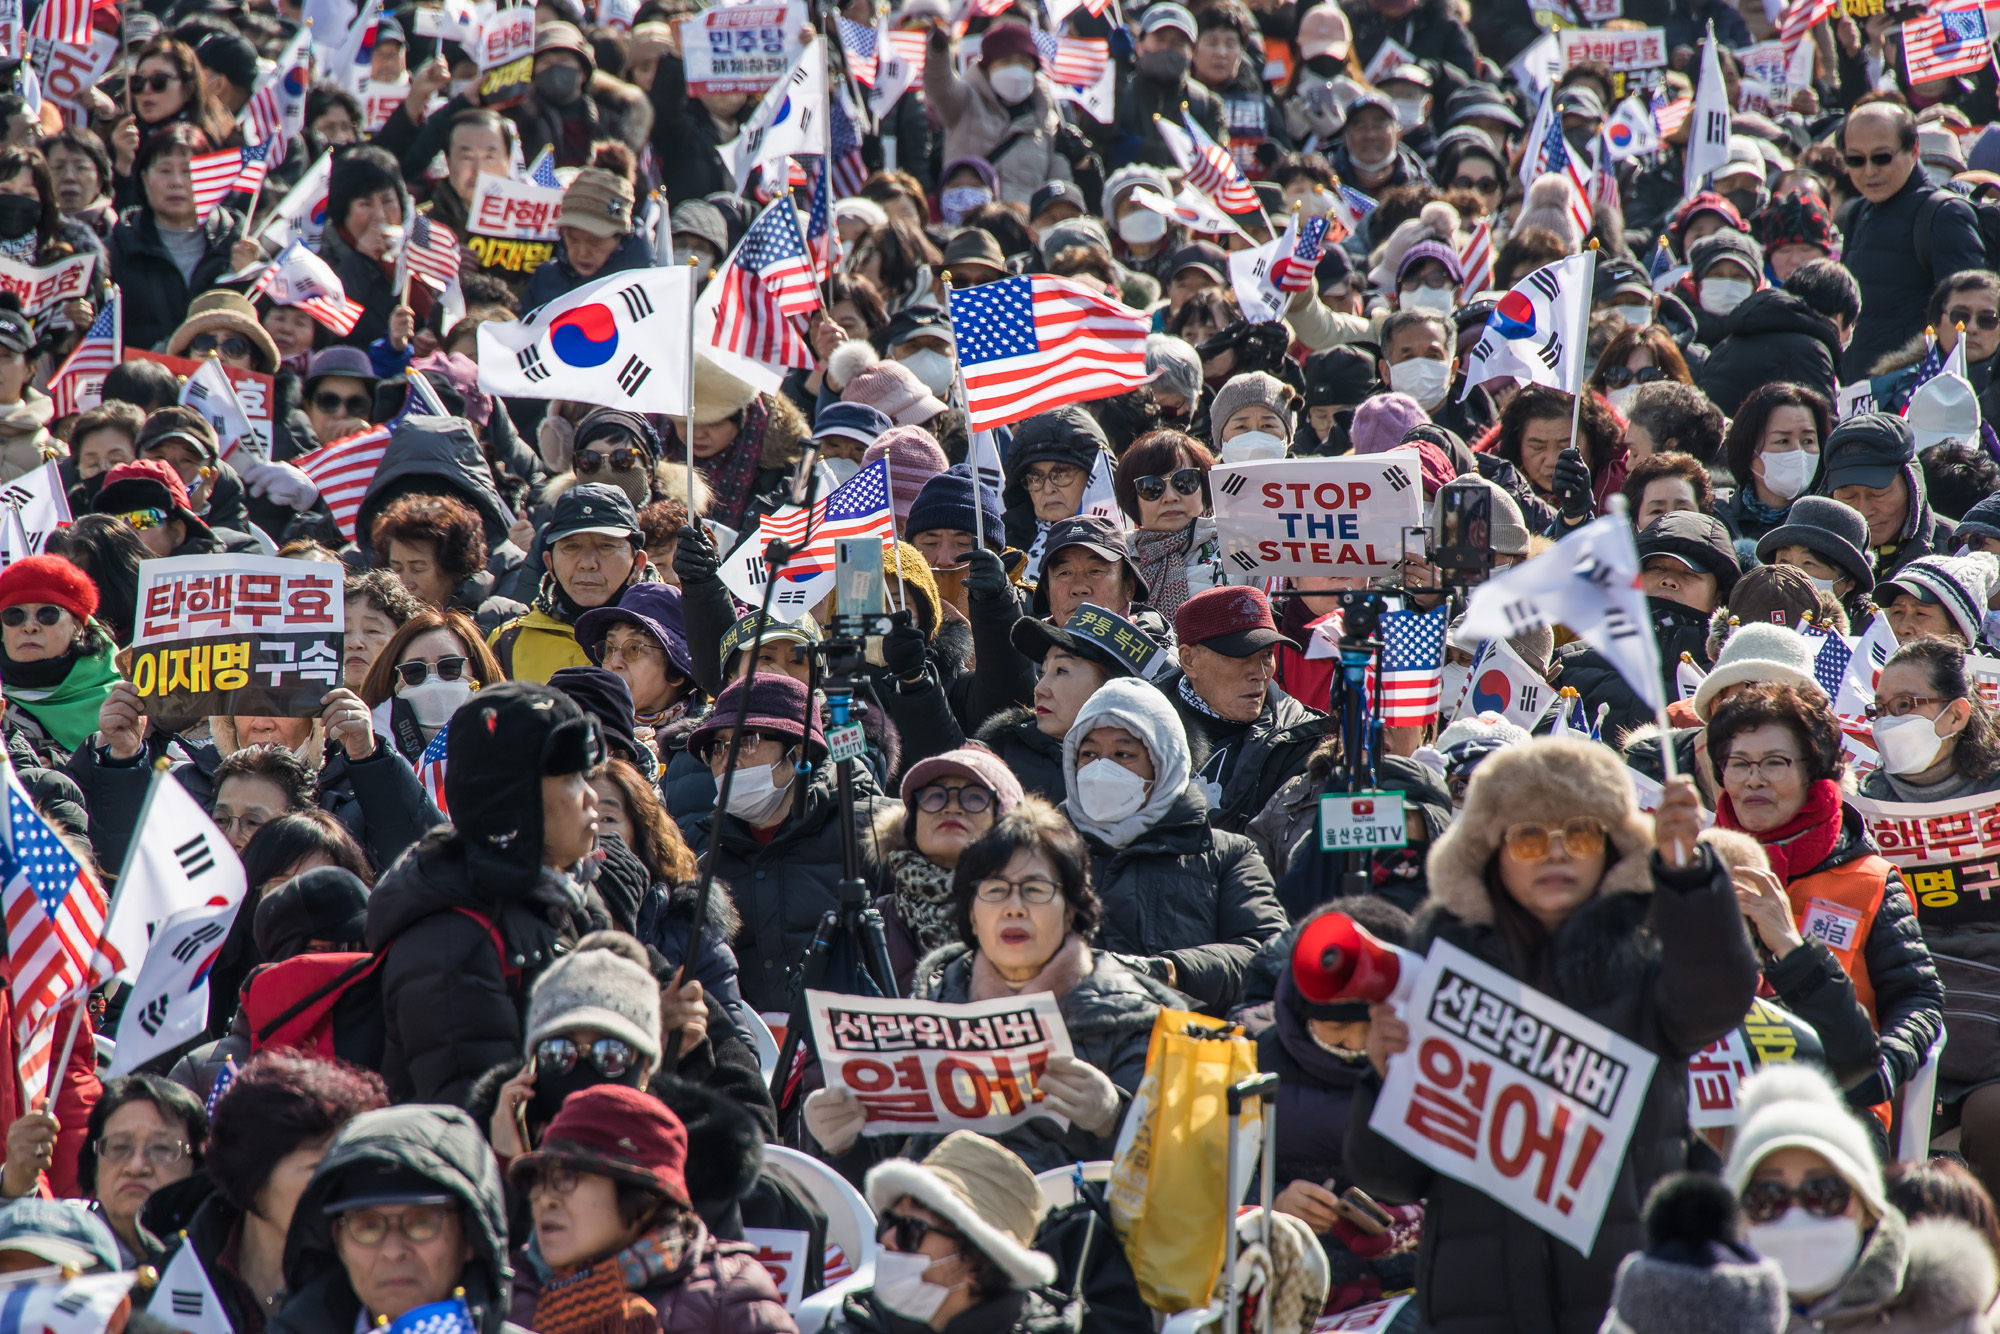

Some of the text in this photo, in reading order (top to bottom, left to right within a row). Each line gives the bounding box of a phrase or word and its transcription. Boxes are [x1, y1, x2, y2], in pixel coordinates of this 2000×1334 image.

[709, 28, 784, 53] 민주당
[1568, 36, 1660, 68] 탄핵무효
[1261, 482, 1373, 511] STOP
[1278, 512, 1361, 541] THE
[1258, 540, 1389, 567] STEAL
[142, 574, 334, 638] 탄핵무효
[132, 640, 340, 698] 이재명 구속
[398, 718, 421, 753] GUESS
[1325, 825, 1402, 846] 울산우리TV
[1812, 918, 1847, 946] 헌금
[834, 1011, 1041, 1050] 선관위서버
[1430, 974, 1627, 1118] 선관위서버
[1404, 1036, 1604, 1218] 열어!
